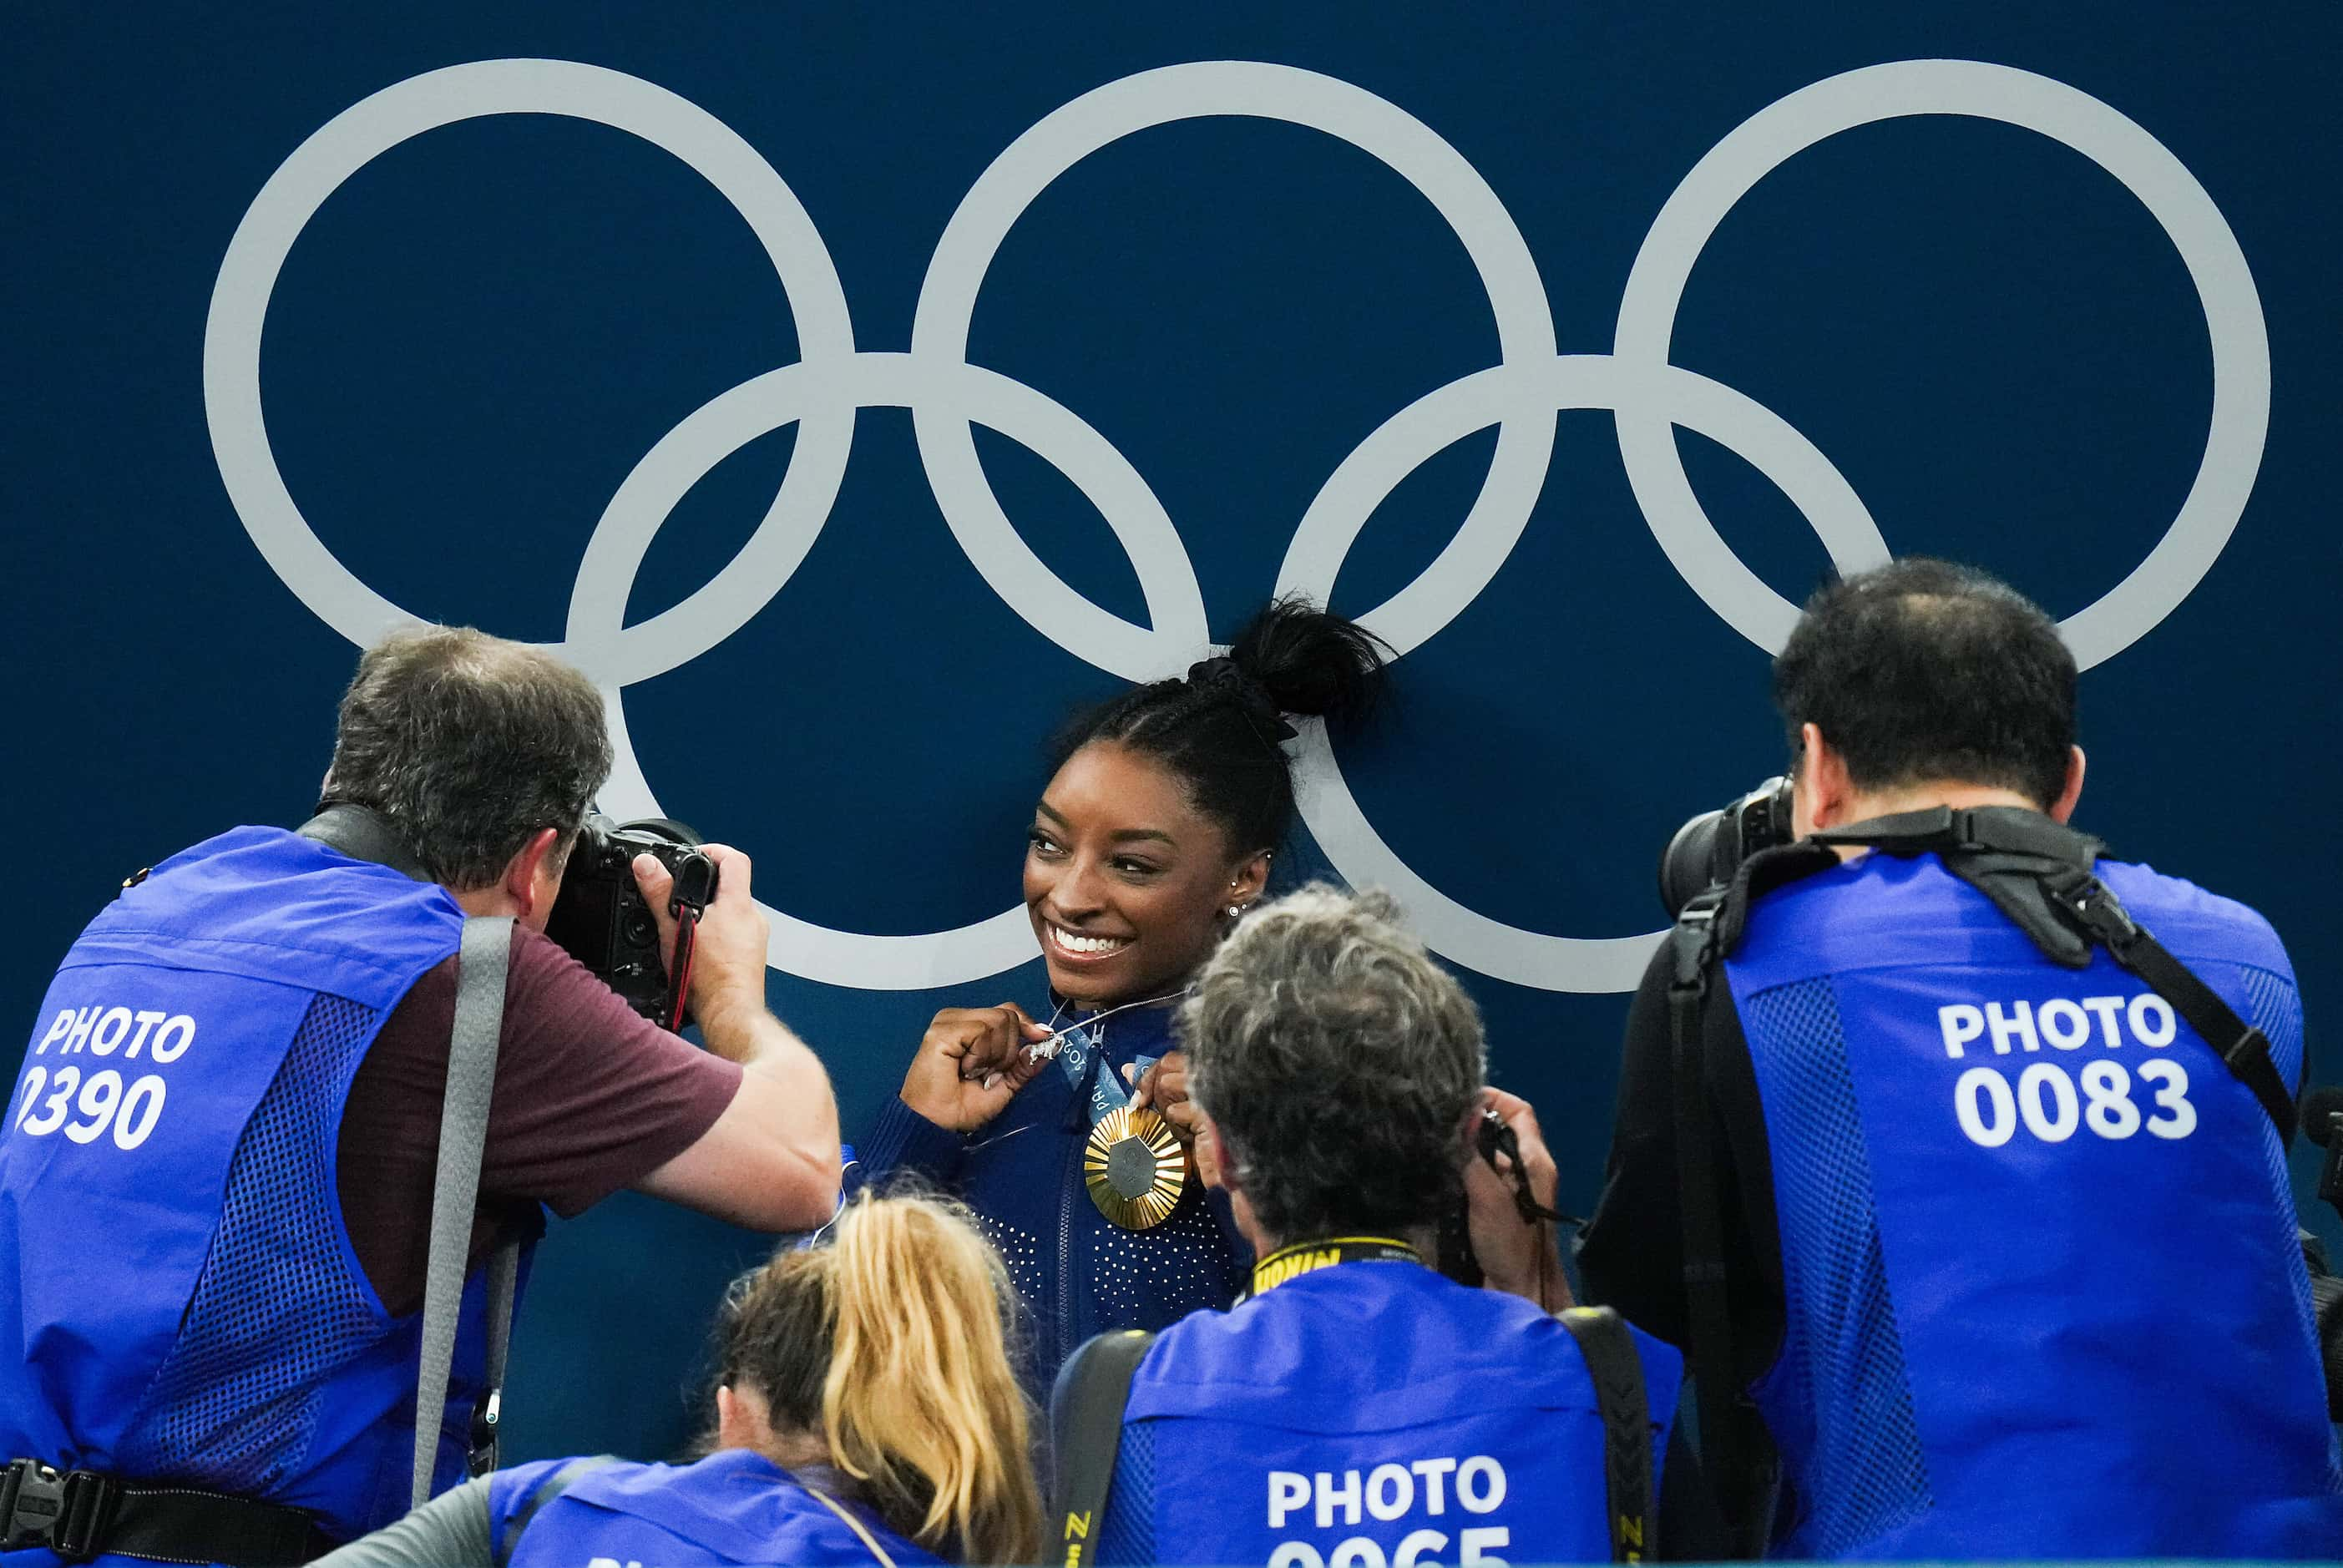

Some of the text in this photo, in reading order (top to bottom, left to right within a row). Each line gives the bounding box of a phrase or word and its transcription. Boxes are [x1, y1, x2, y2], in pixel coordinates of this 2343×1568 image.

[36, 1006, 196, 1063] PHOTO
[1938, 994, 2177, 1059] PHOTO
[14, 1066, 167, 1151] 0390
[1955, 1059, 2197, 1147] 0083
[1268, 1455, 1507, 1528] PHOTO
